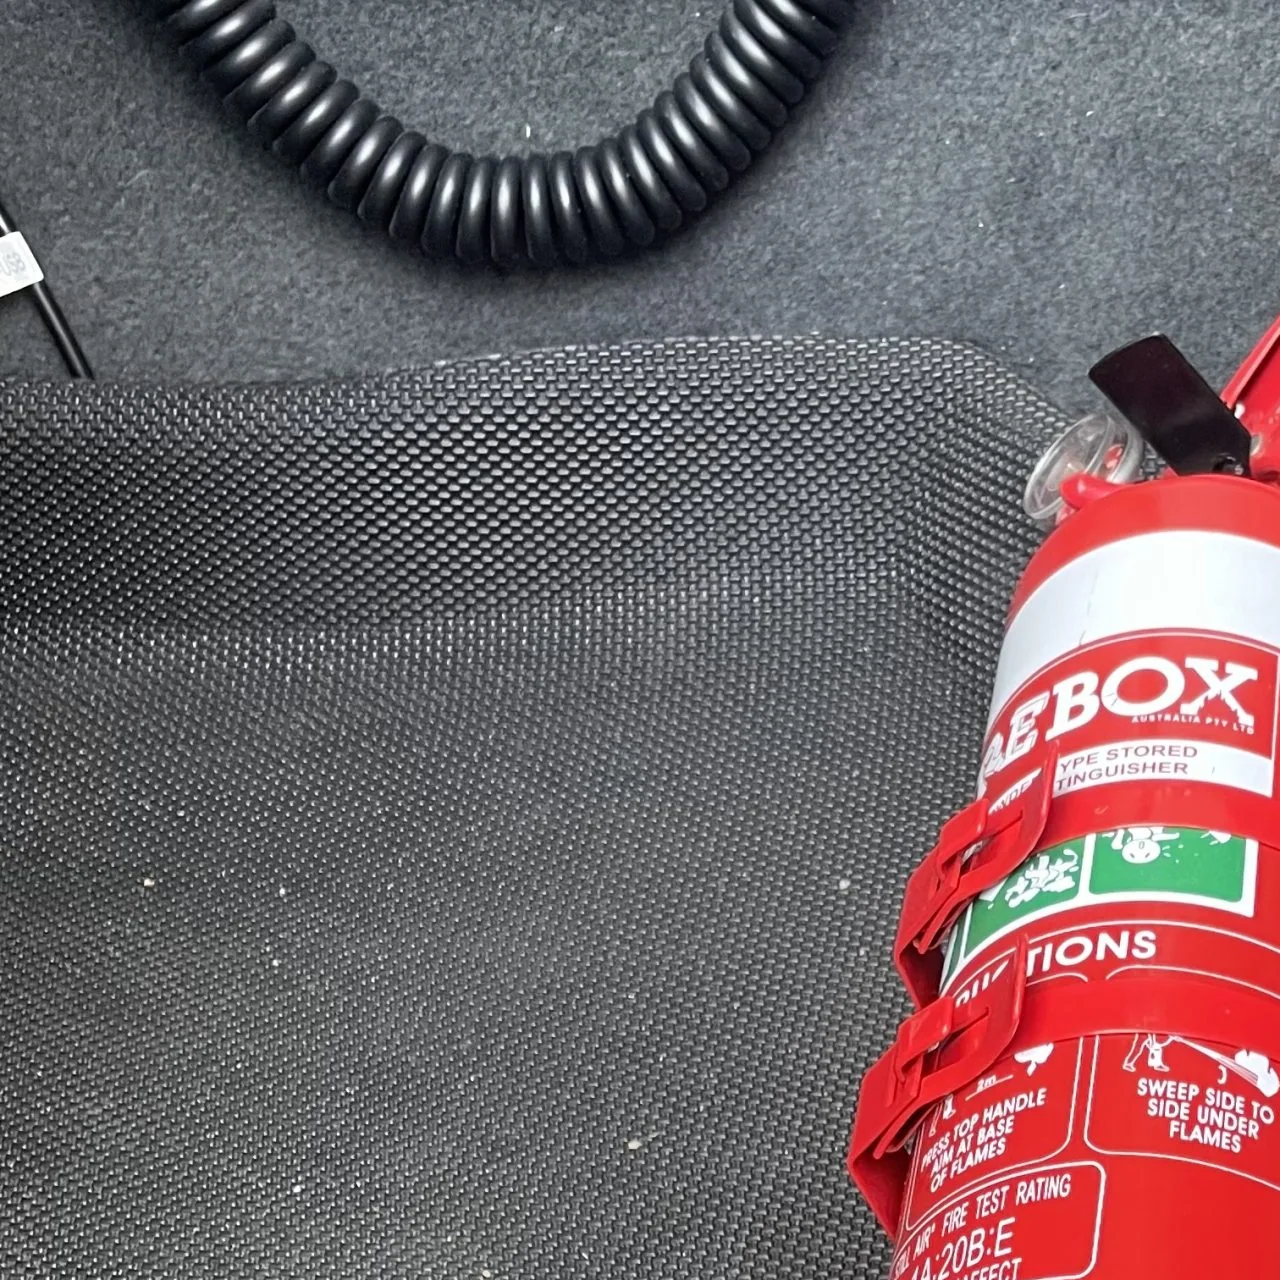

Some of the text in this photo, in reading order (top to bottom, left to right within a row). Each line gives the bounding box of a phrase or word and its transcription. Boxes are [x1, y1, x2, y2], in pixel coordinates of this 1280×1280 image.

[1131, 713, 1200, 724] AUSTRALIA
[1055, 761, 1189, 791] TINGUISHER
[1060, 745, 1198, 774] YPE STORED
[954, 1112, 979, 1142] TOP
[982, 1087, 1047, 1124] HANDLE
[1137, 1077, 1275, 1125] SWEEP SIDE TO
[1147, 1098, 1260, 1140] SIDE UNDER
[930, 1115, 1015, 1178] AIM AT BASE
[1169, 1120, 1242, 1153] FLAMES
[931, 1138, 1006, 1193] OF FLAMES
[941, 1201, 969, 1237] FIRE
[975, 1185, 1010, 1221] TEST
[1015, 1174, 1071, 1206] RATING
